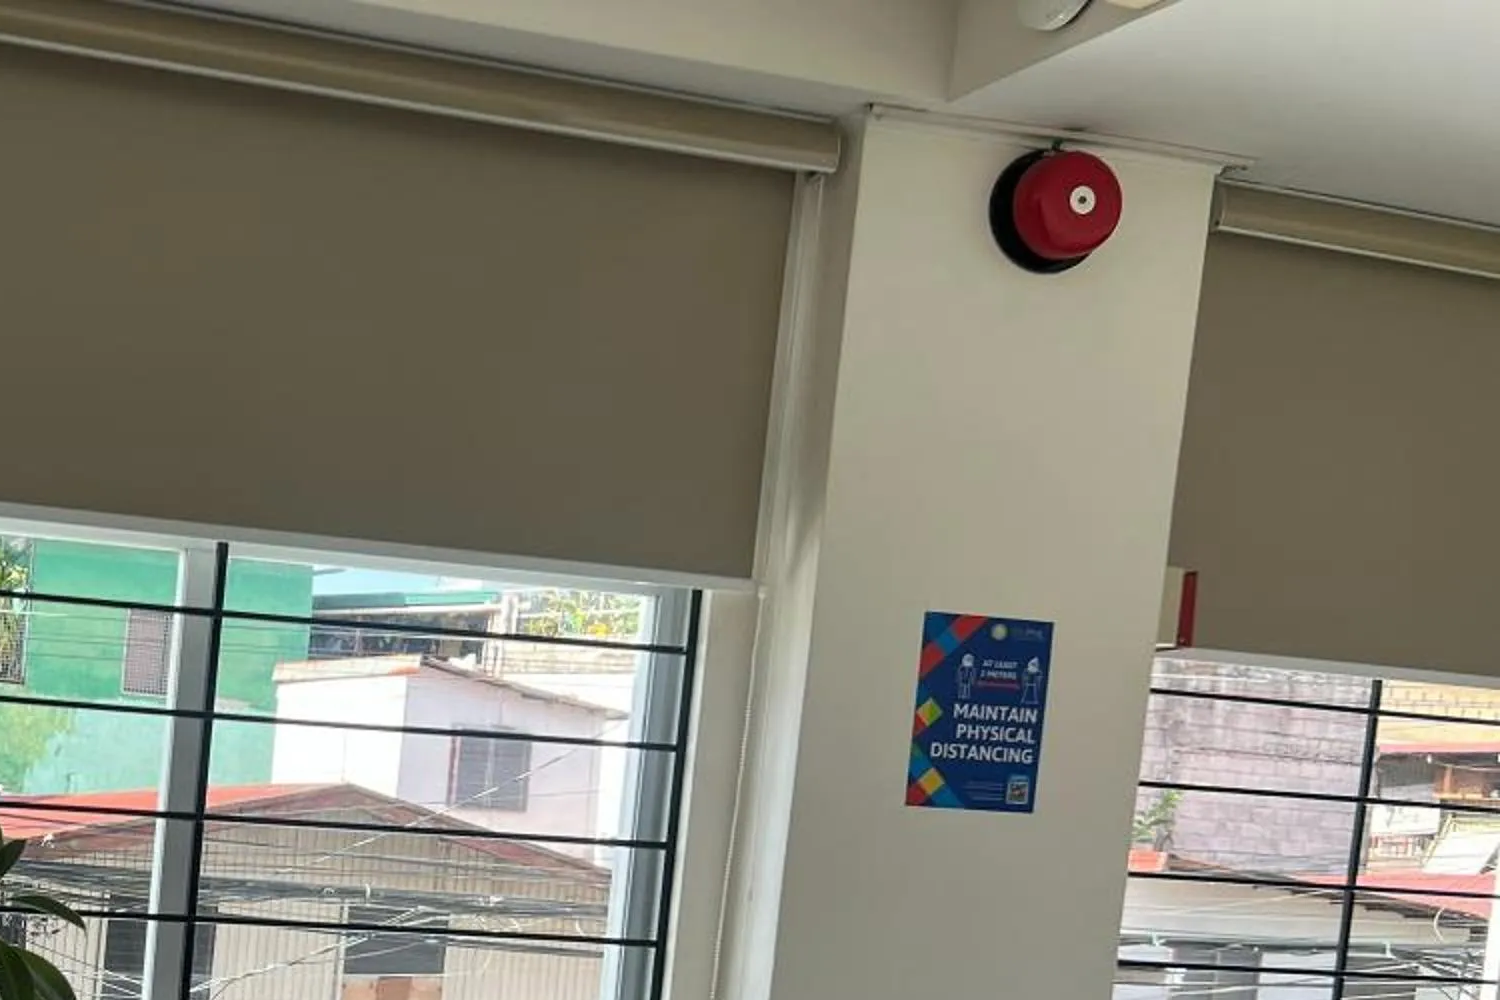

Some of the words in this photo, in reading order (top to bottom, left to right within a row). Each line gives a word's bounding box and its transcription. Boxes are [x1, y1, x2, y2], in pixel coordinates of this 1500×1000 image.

[953, 703, 1038, 724] MAINTAIN
[955, 723, 1036, 745] PHYSICAL
[930, 742, 1034, 765] DISTANCING
